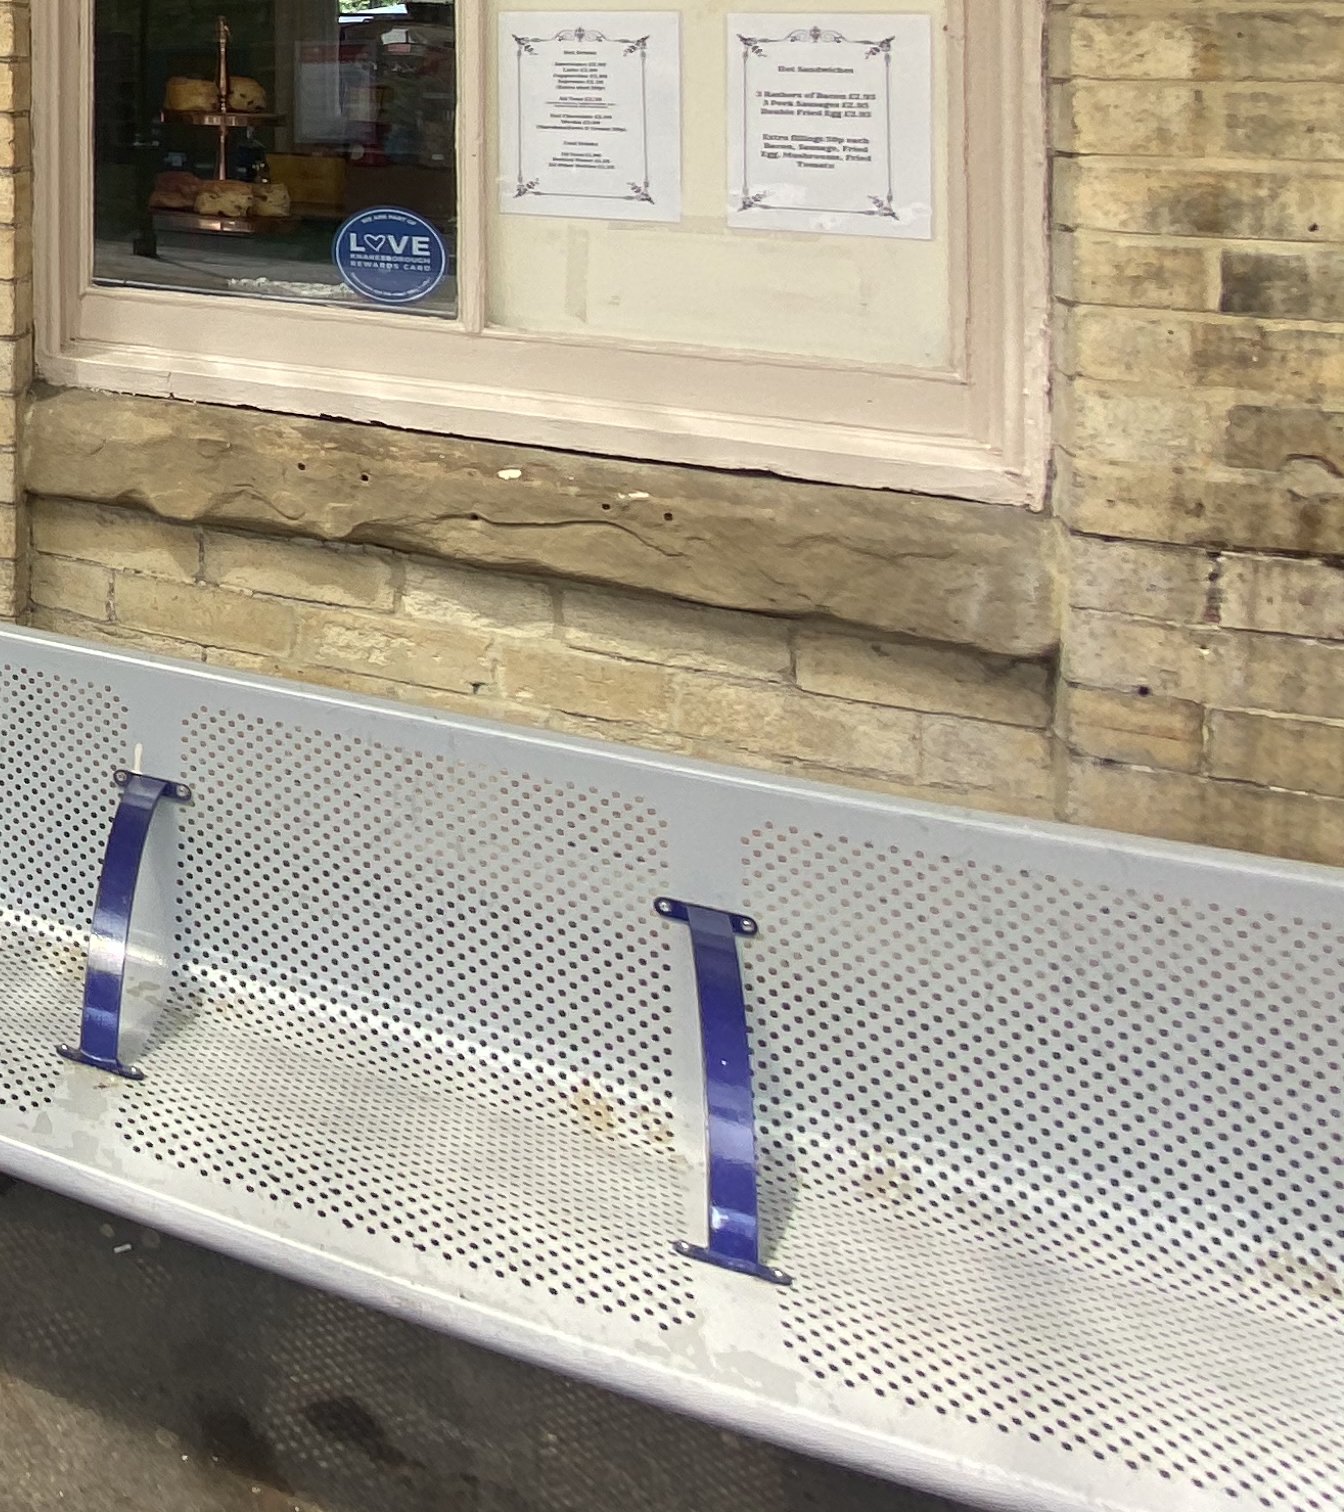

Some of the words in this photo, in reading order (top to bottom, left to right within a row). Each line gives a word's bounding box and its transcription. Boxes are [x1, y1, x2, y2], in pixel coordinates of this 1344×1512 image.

[350, 253, 431, 265] KNARESBOROUGH
[350, 260, 400, 270] REWARDS
[403, 263, 431, 272] CARD
